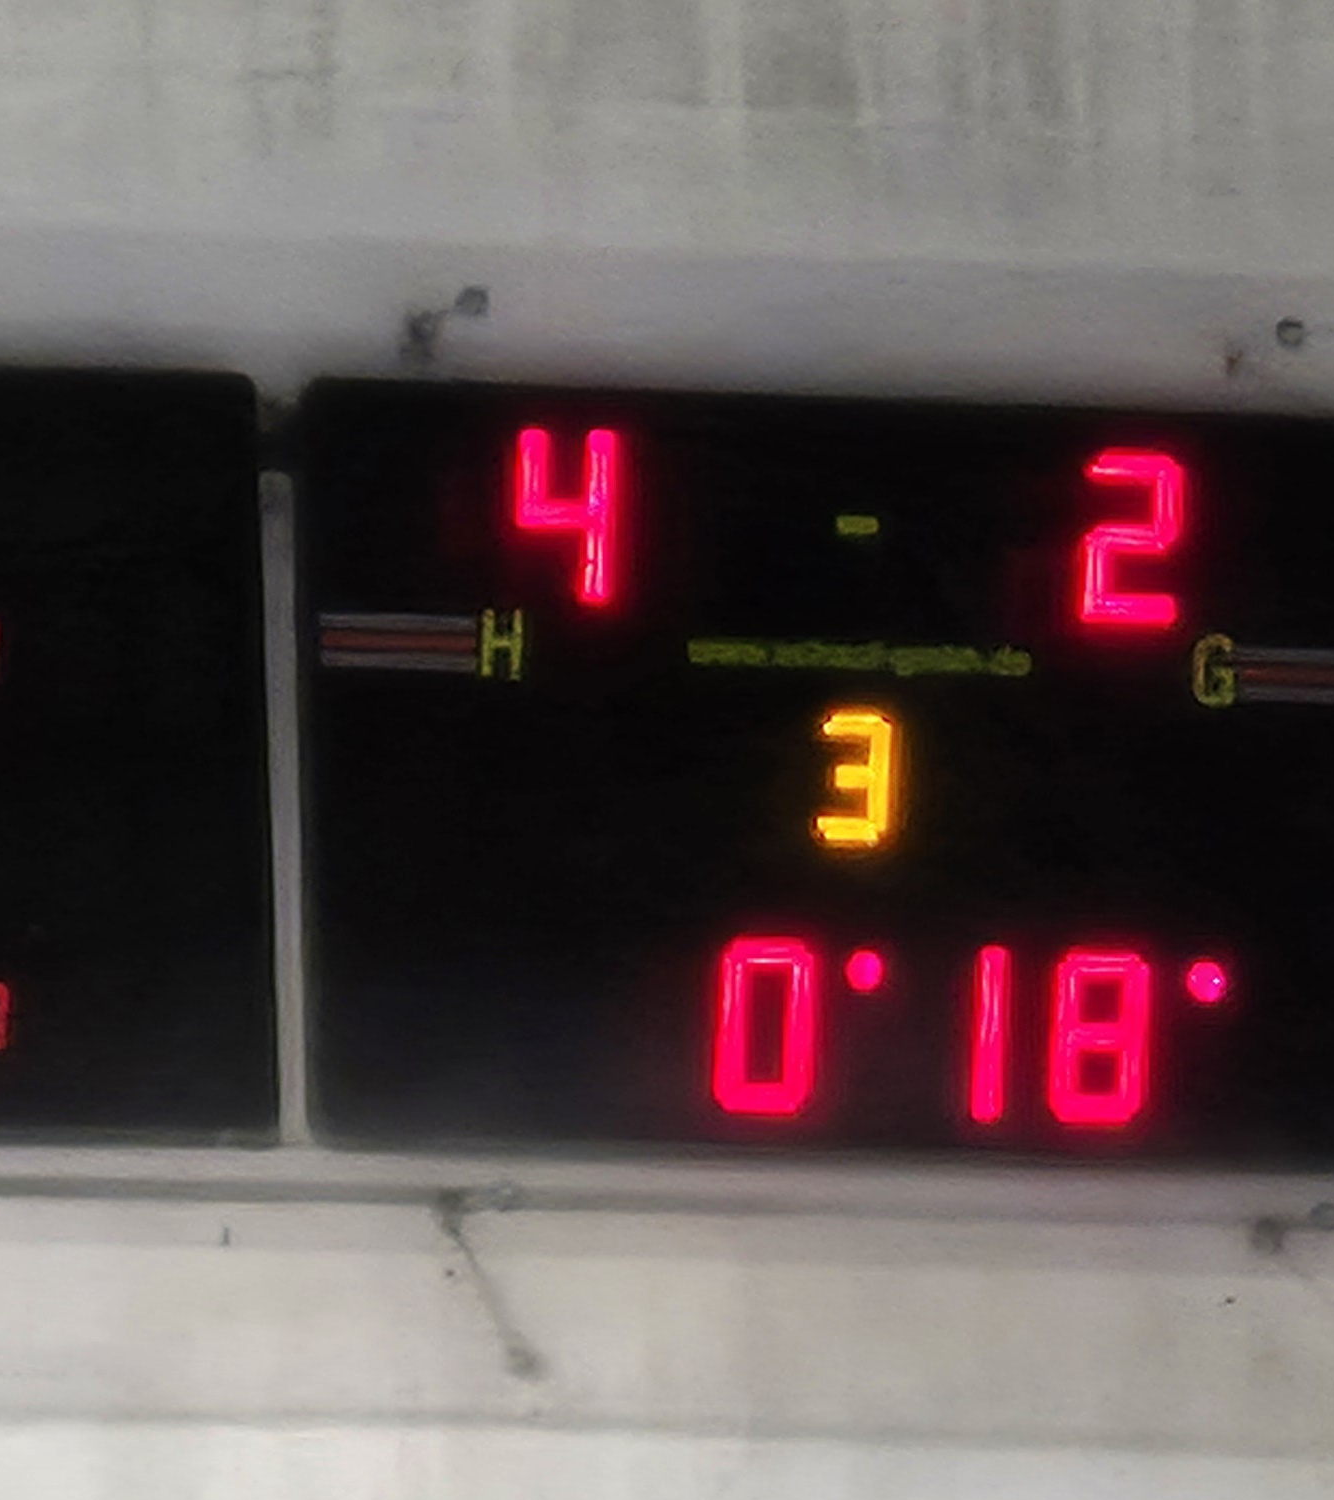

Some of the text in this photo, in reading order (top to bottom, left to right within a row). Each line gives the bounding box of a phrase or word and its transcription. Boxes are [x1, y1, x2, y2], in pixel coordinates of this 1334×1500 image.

[512, 427, 624, 605] 4
[1075, 447, 1189, 634] 2
[481, 608, 524, 680] H
[1191, 634, 1239, 707] G
[813, 708, 901, 849] 3
